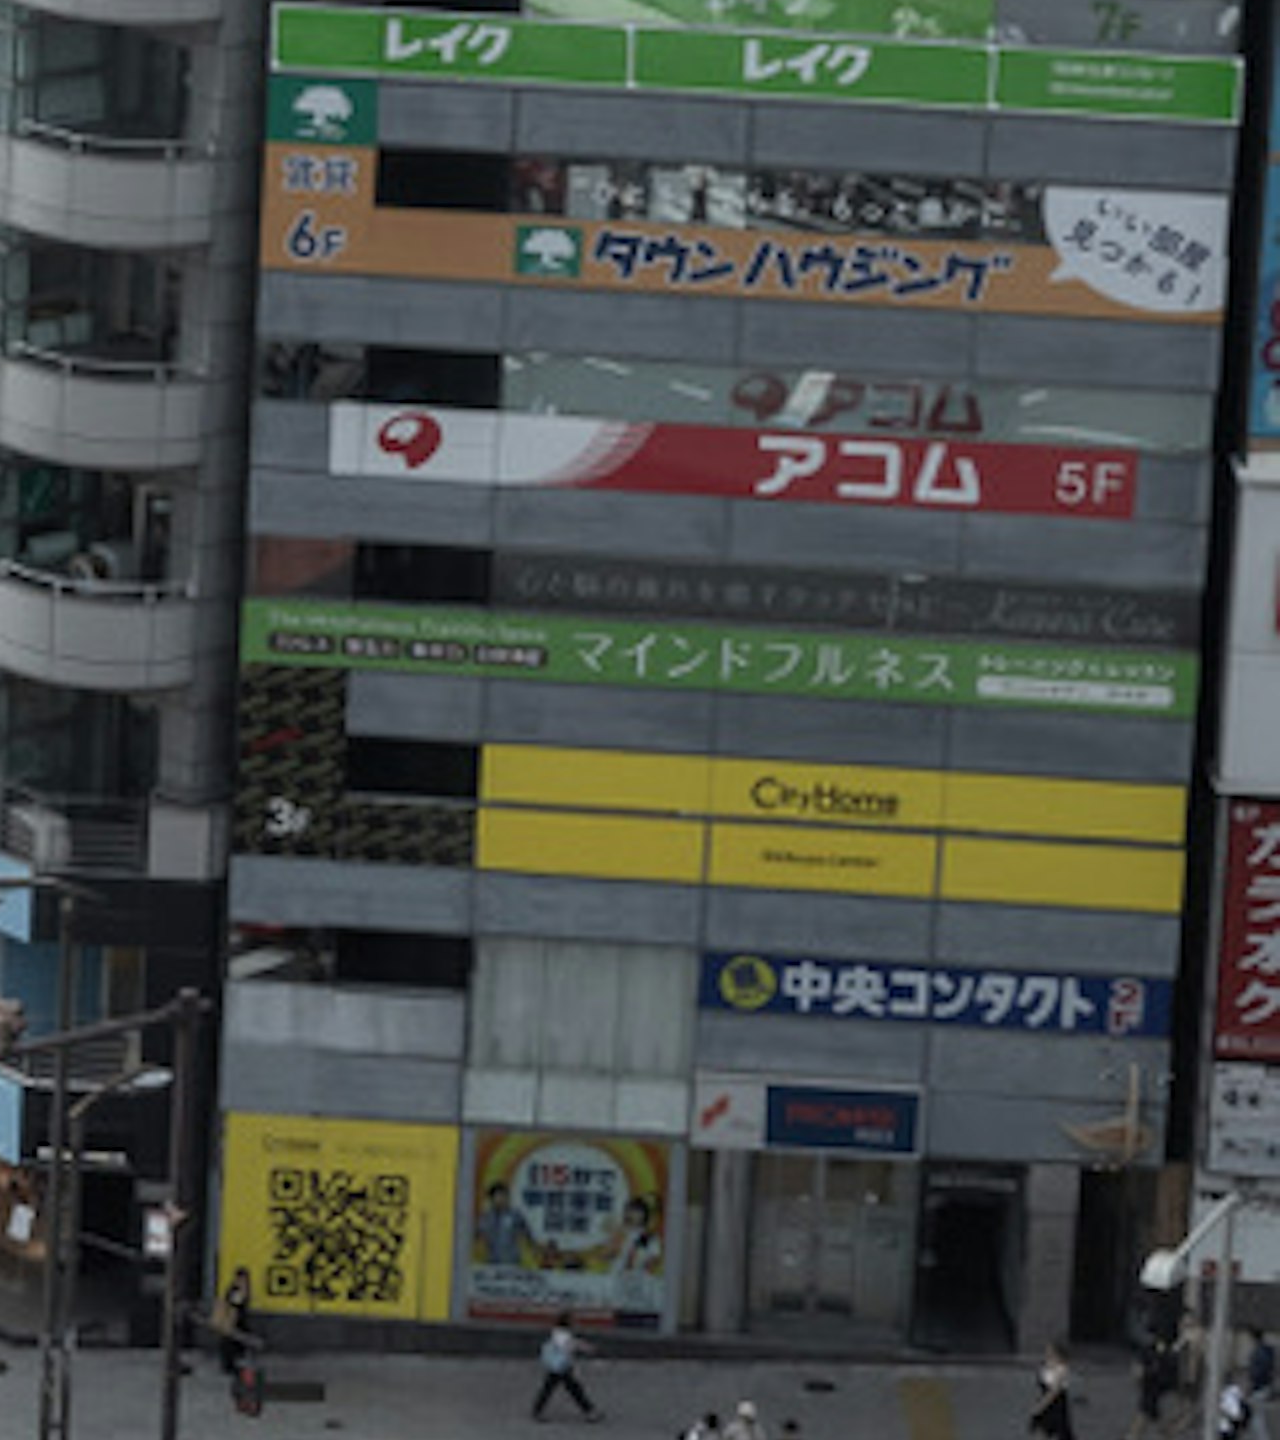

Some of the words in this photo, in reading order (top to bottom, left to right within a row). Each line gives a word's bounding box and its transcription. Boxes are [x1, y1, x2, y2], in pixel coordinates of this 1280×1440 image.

[383, 17, 513, 65] レイク
[741, 38, 872, 85] レイク
[288, 212, 347, 258] 6F
[593, 227, 1014, 301] タウンハウジング
[753, 434, 982, 504] アコム
[1054, 461, 1127, 504] 5F
[572, 631, 957, 692] マインドフルネス
[780, 961, 1096, 1029] 中央コンタクト
